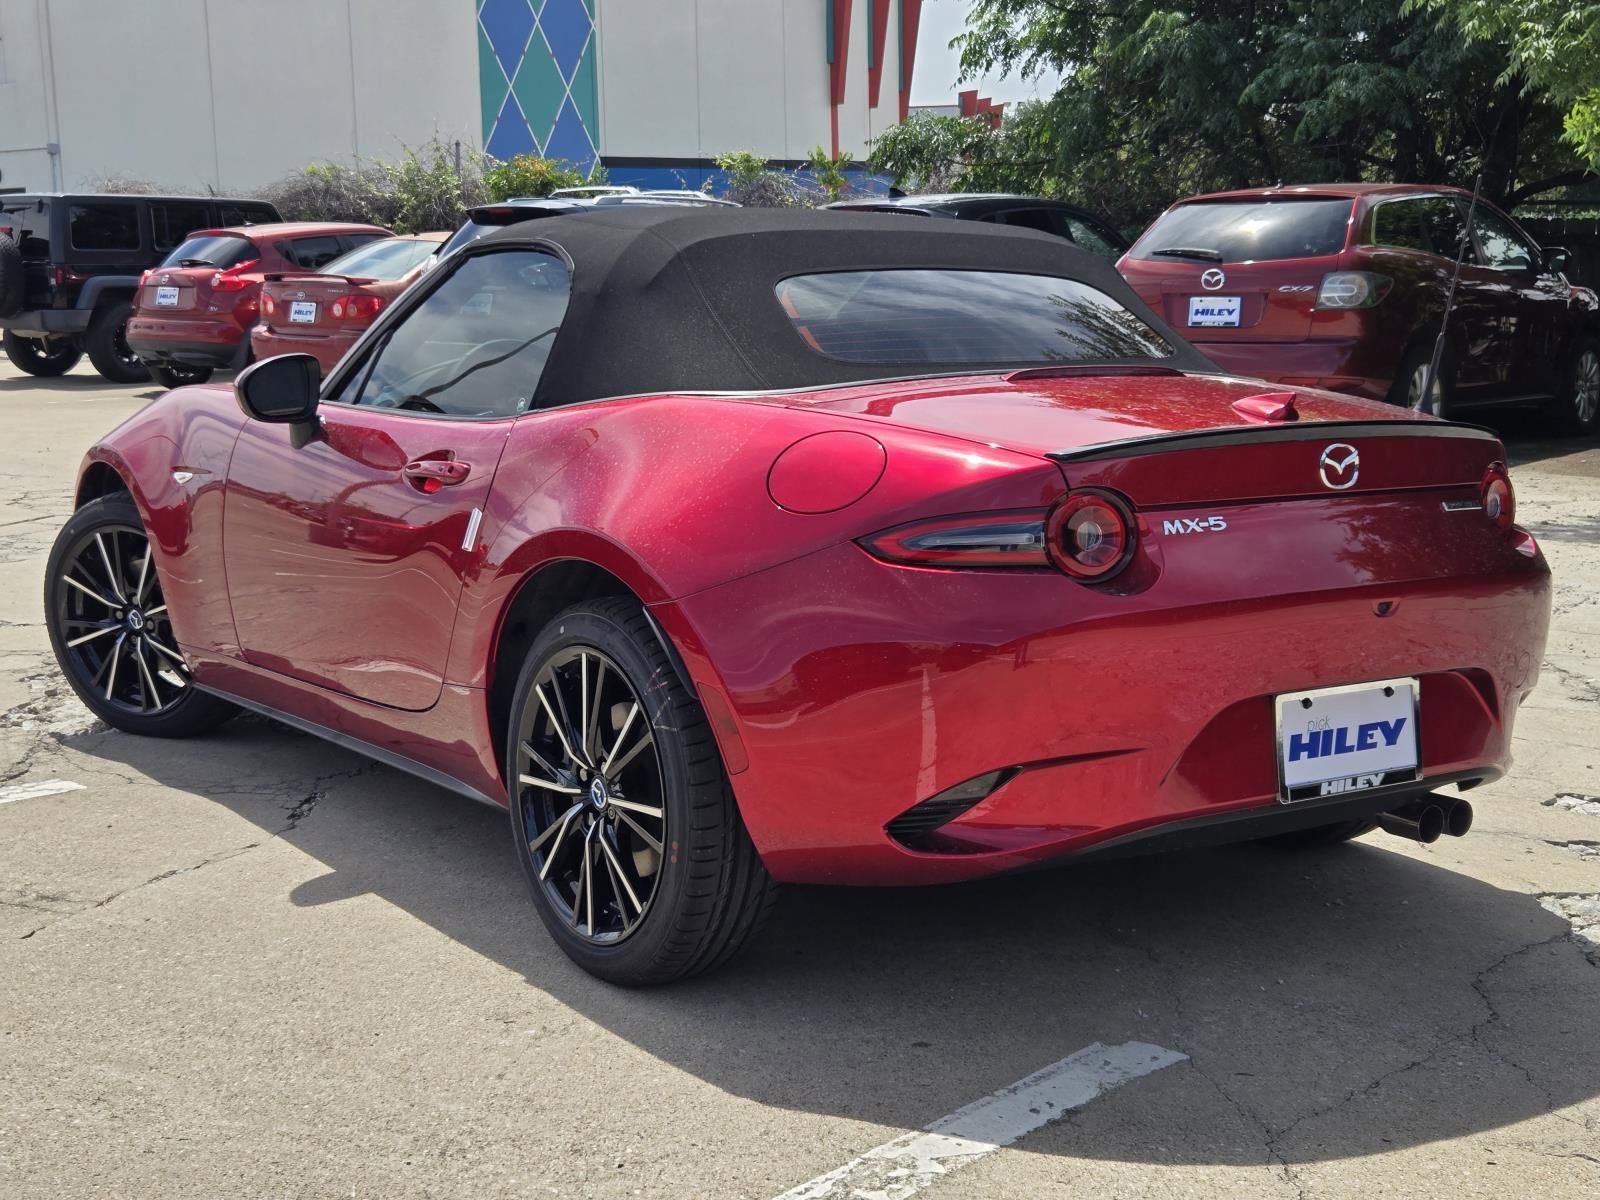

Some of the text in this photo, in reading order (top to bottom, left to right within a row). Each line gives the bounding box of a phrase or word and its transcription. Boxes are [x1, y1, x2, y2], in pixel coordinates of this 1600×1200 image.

[1193, 308, 1237, 316] HILEY
[1163, 516, 1227, 536] MX-5
[1288, 717, 1407, 762] HILEY
[1319, 772, 1385, 796] HILEY
